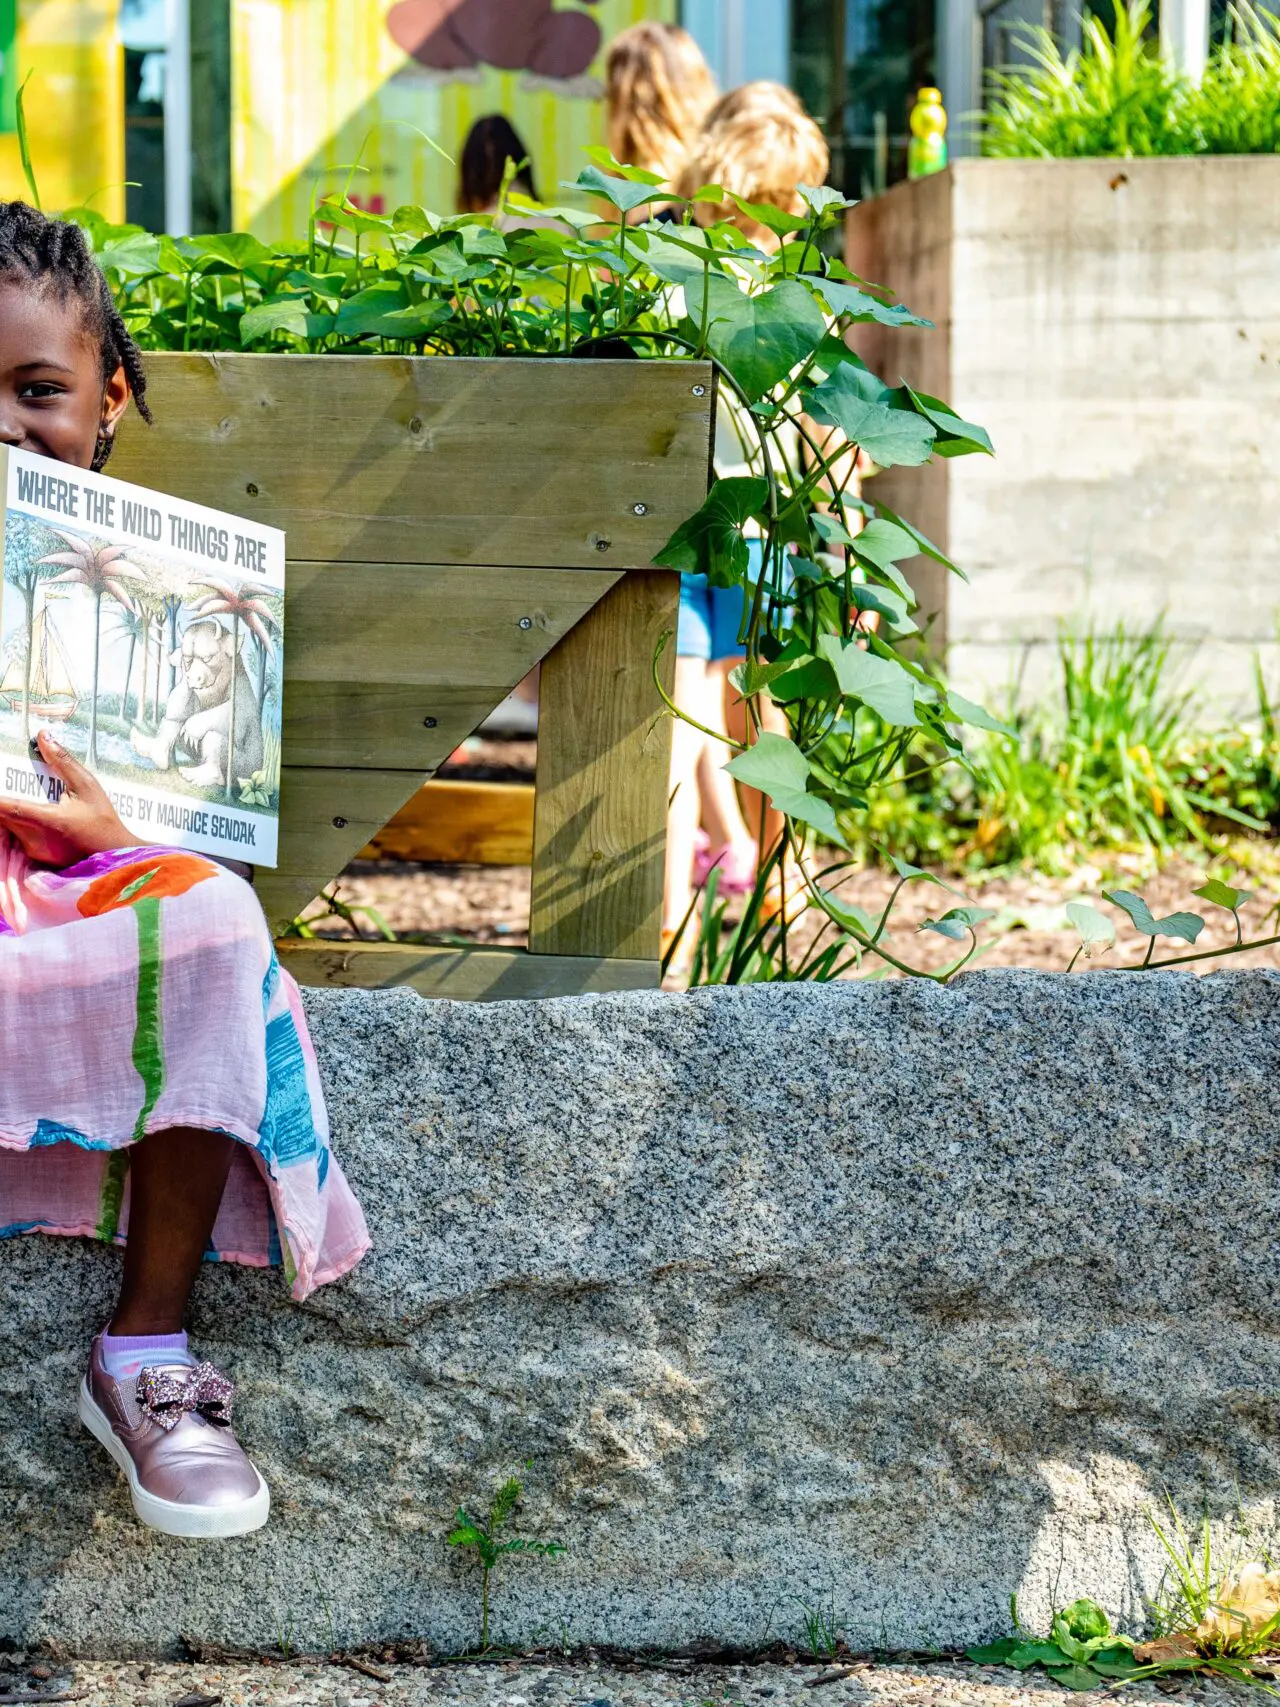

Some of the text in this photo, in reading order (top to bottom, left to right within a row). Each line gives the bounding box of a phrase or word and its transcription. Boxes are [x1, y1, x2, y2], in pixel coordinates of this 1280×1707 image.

[17, 466, 267, 573] WHERE THE WILD THINGS ARE
[5, 767, 43, 796] STORY
[47, 776, 65, 802] AN
[138, 797, 153, 822] BY
[157, 806, 209, 836] MAURICE
[211, 816, 257, 847] SENDAK
